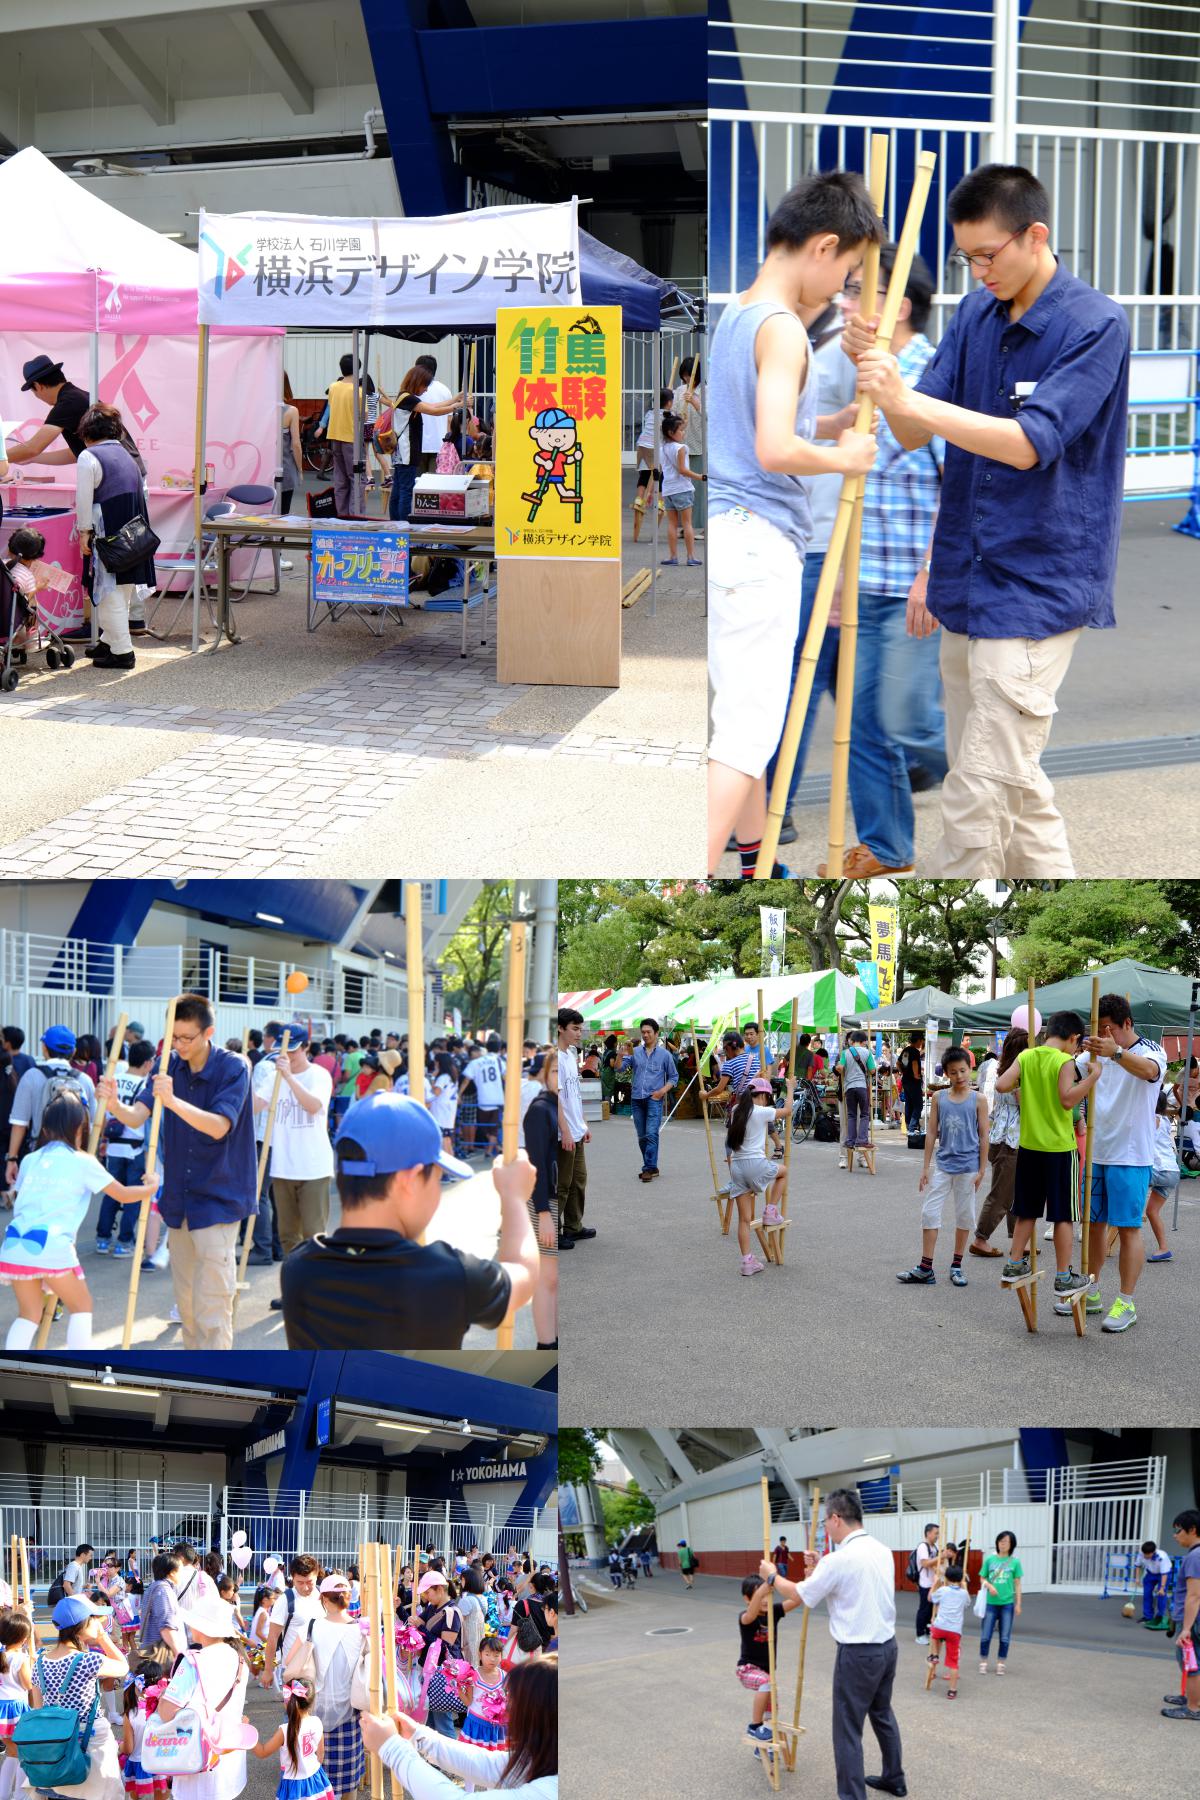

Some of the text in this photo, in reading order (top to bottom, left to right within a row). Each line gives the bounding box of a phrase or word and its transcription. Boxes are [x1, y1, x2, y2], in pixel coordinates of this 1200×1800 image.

[256, 237, 361, 251] 学校法人 石川学園
[253, 248, 578, 297] 横浜デザイン学院
[507, 317, 606, 375] 竹馬
[512, 376, 607, 421] 体験
[416, 496, 439, 509] りんご
[523, 533, 612, 546] 横浜デザイン学院
[876, 921, 891, 961] 夢馬
[482, 1066, 497, 1083] 18
[466, 1462, 527, 1480] YOKOHAMA
